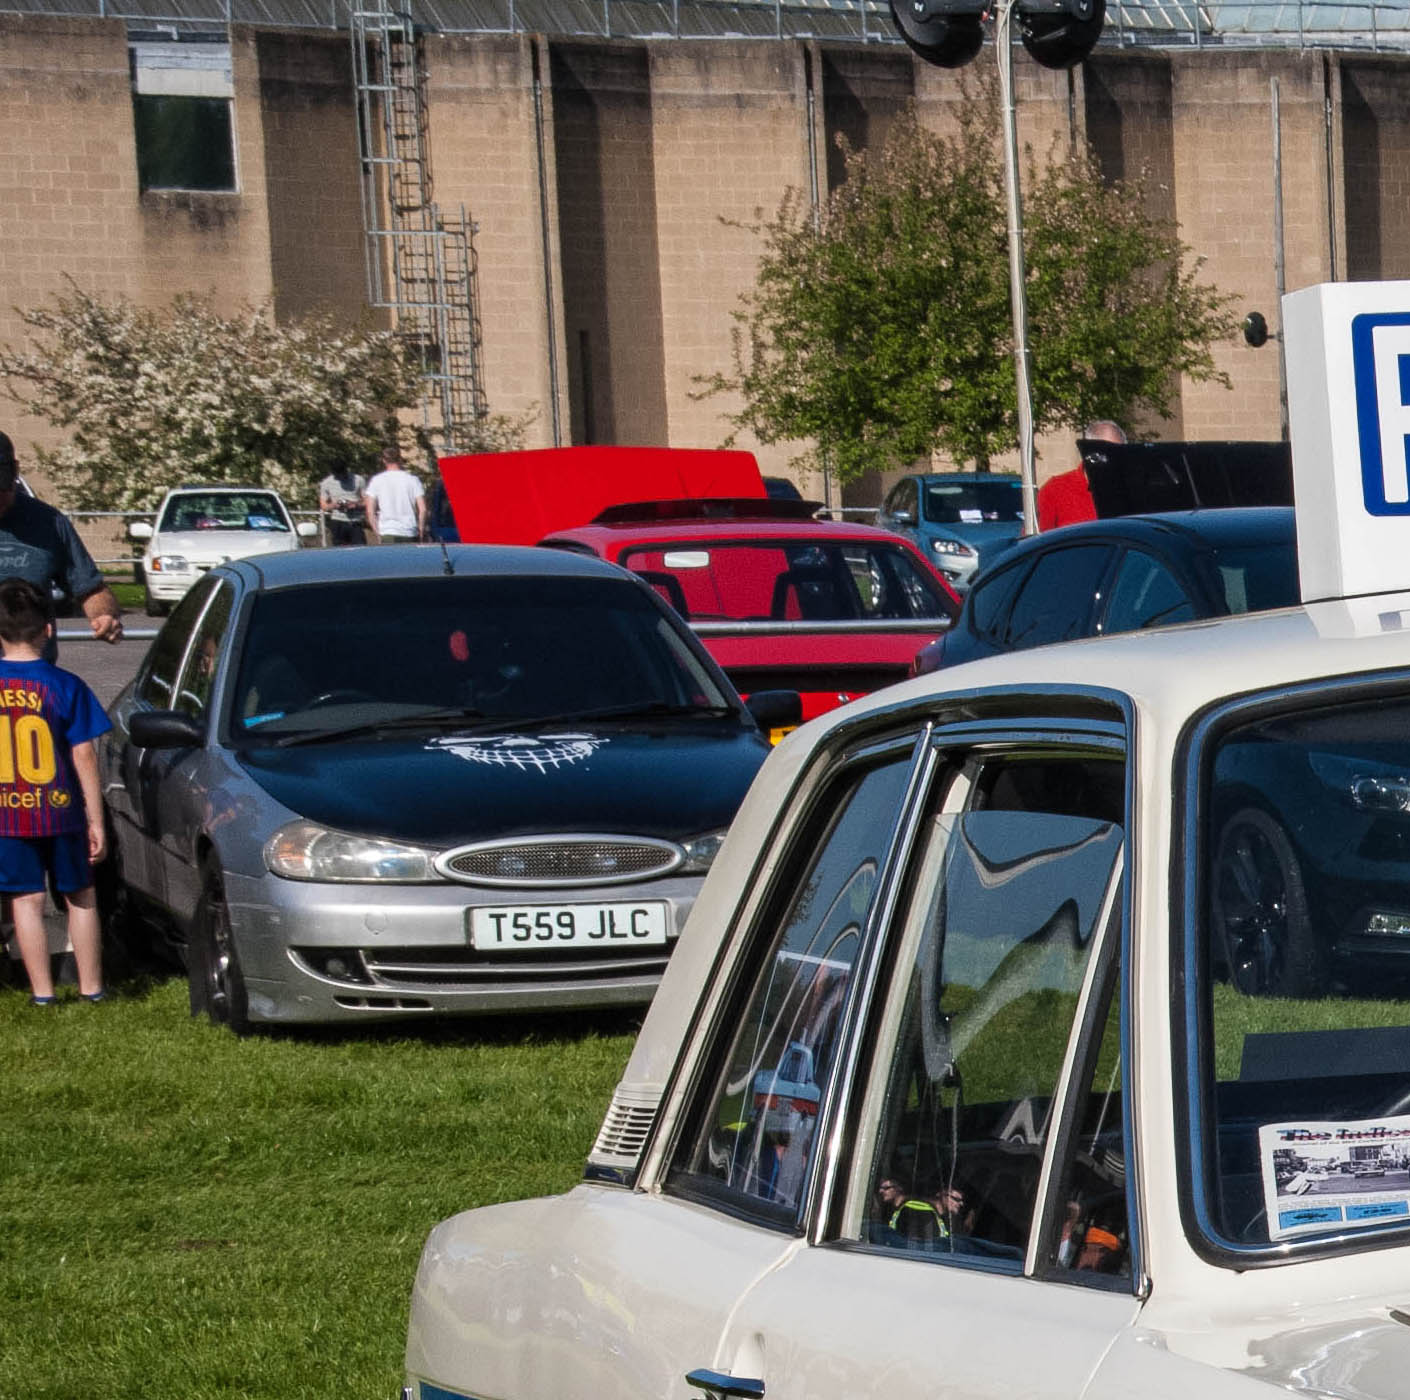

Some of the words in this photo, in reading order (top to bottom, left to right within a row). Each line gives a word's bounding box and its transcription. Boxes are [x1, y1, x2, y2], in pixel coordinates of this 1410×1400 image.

[488, 911, 576, 942] T559
[588, 909, 650, 939] JLC
[1277, 1129, 1333, 1141] The
